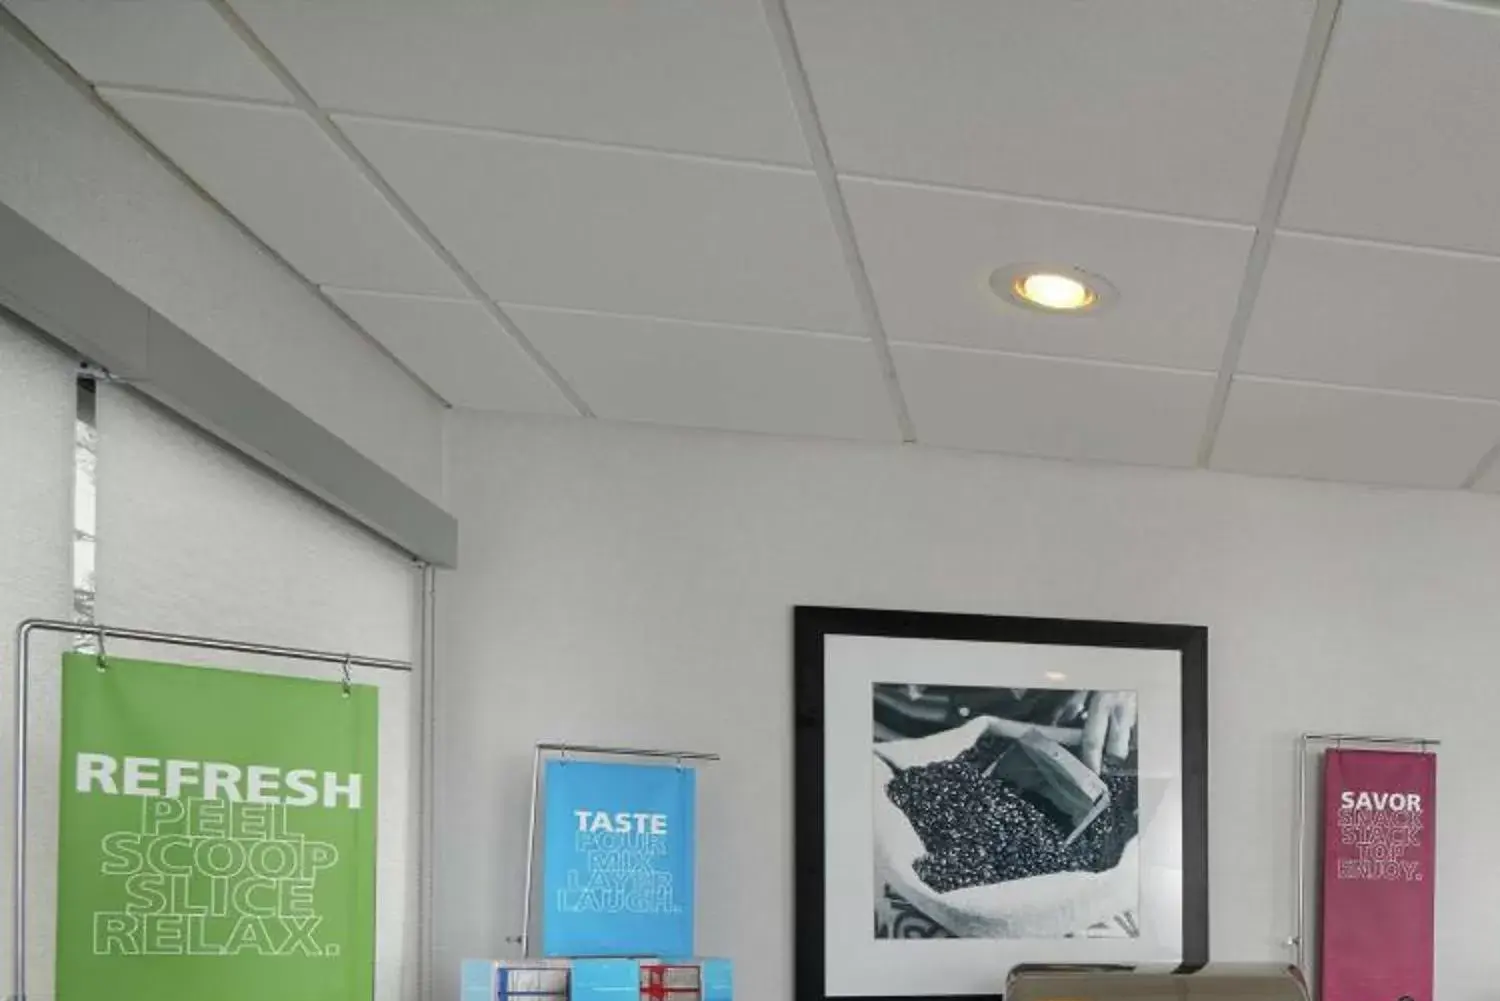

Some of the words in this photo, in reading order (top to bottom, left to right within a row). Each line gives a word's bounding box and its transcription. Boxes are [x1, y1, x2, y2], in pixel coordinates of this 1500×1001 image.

[75, 751, 363, 810] REFRESH
[1341, 791, 1422, 812] SAVOR
[142, 795, 305, 841] PEEL
[573, 809, 669, 835] TASTE
[575, 831, 668, 856] POUR
[1341, 825, 1421, 848] STACK
[101, 831, 339, 880] SCOOP
[588, 849, 657, 873] MIX
[1356, 841, 1409, 862] TOP
[1337, 859, 1423, 881] ENJOY.
[125, 871, 318, 919] SLICE
[93, 911, 340, 956] RELAX.
